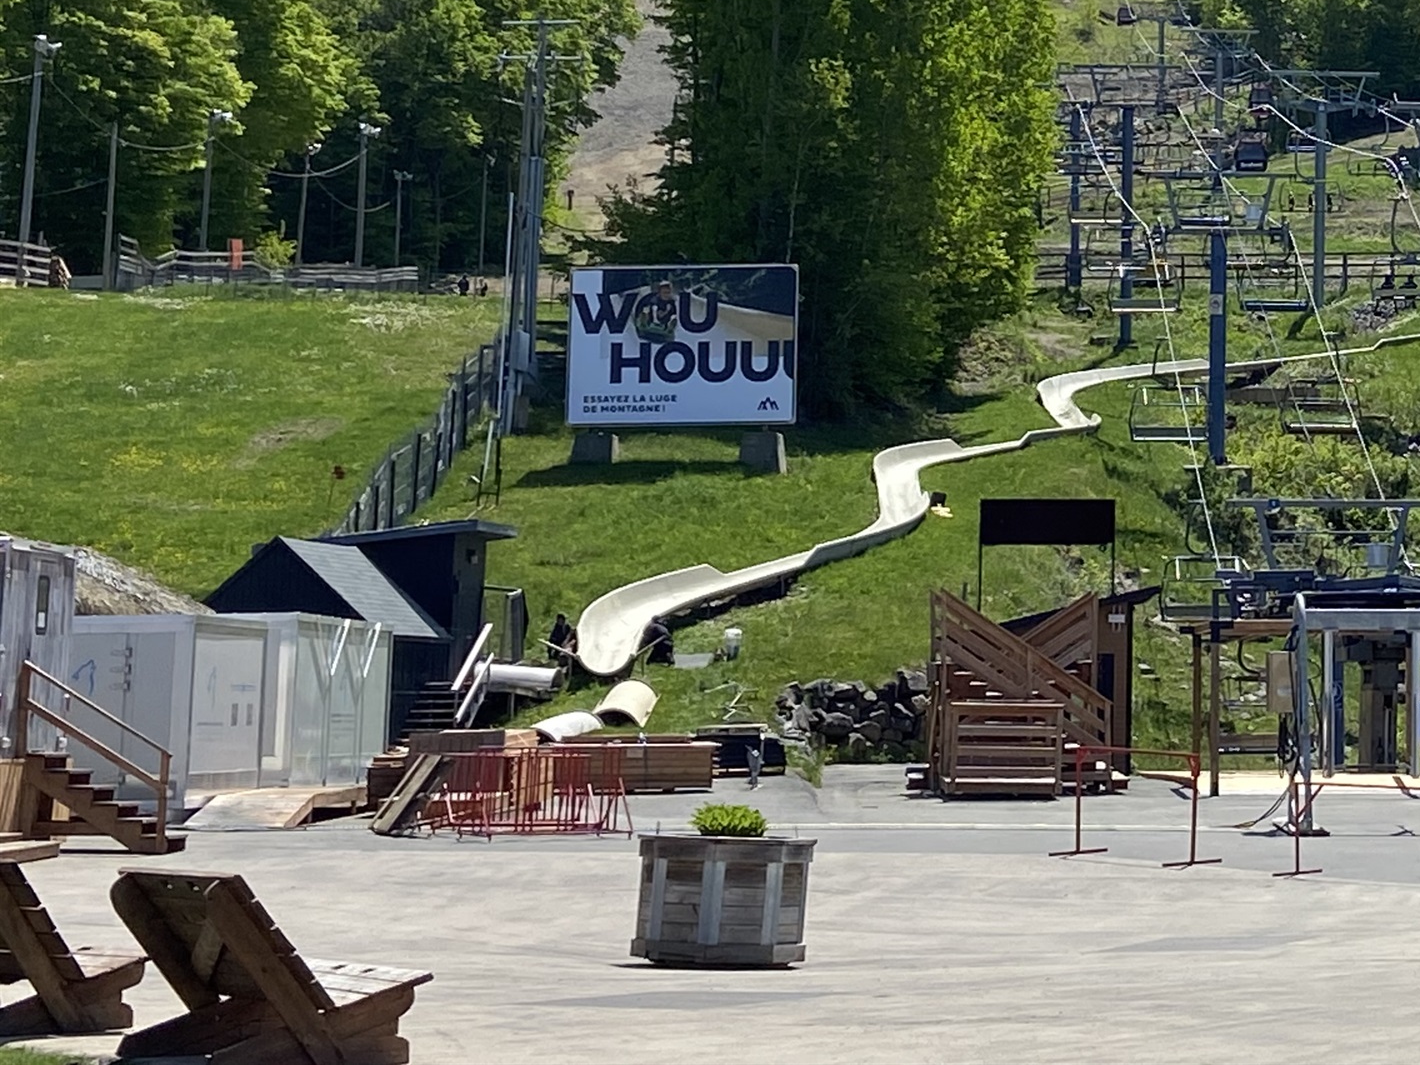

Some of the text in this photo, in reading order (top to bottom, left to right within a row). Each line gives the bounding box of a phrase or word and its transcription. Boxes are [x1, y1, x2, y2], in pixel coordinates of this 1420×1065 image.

[609, 339, 794, 384] HOUU
[583, 395, 630, 403] ESSAYEZ
[649, 394, 678, 402] LUGE
[583, 405, 598, 413] DE
